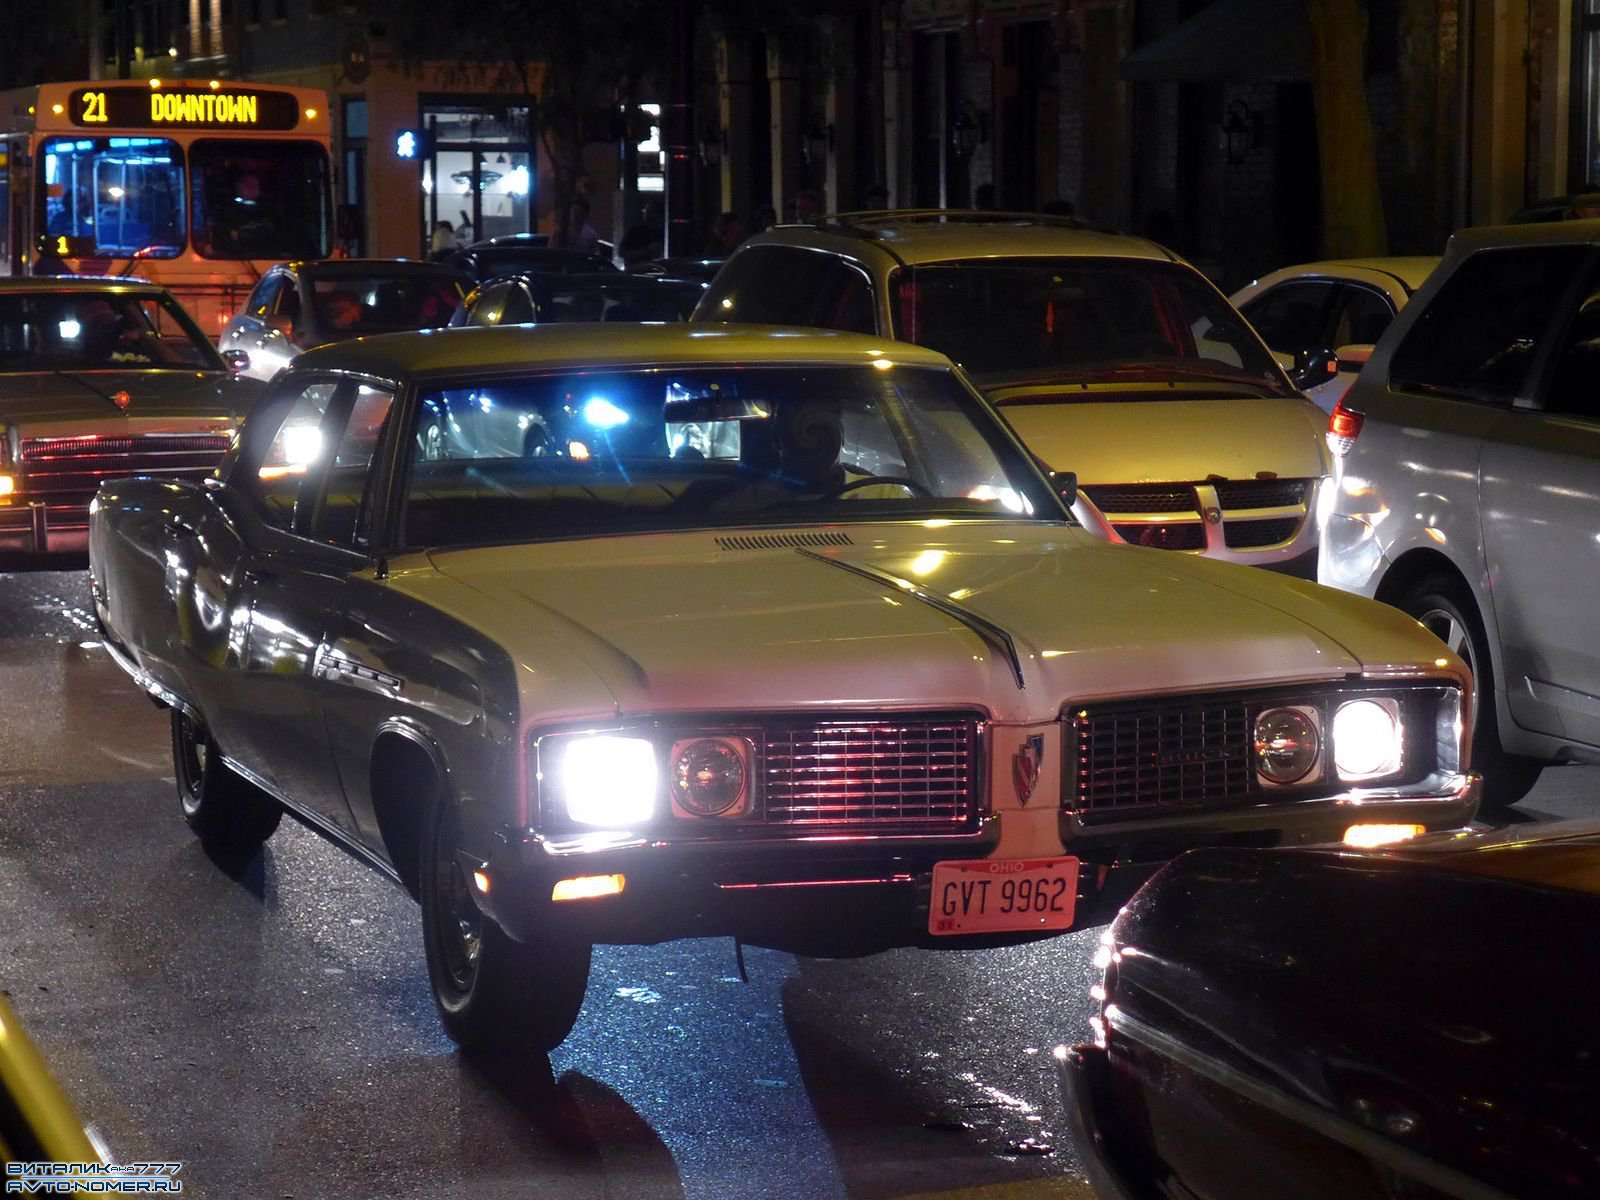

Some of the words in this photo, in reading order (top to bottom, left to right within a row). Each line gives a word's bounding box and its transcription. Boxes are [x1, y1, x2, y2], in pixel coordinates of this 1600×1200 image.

[81, 92, 109, 122] 21
[150, 93, 257, 123] DOWNTOWN
[989, 861, 1025, 873] OHIO
[942, 879, 992, 917] GVT
[999, 876, 1067, 914] 9962
